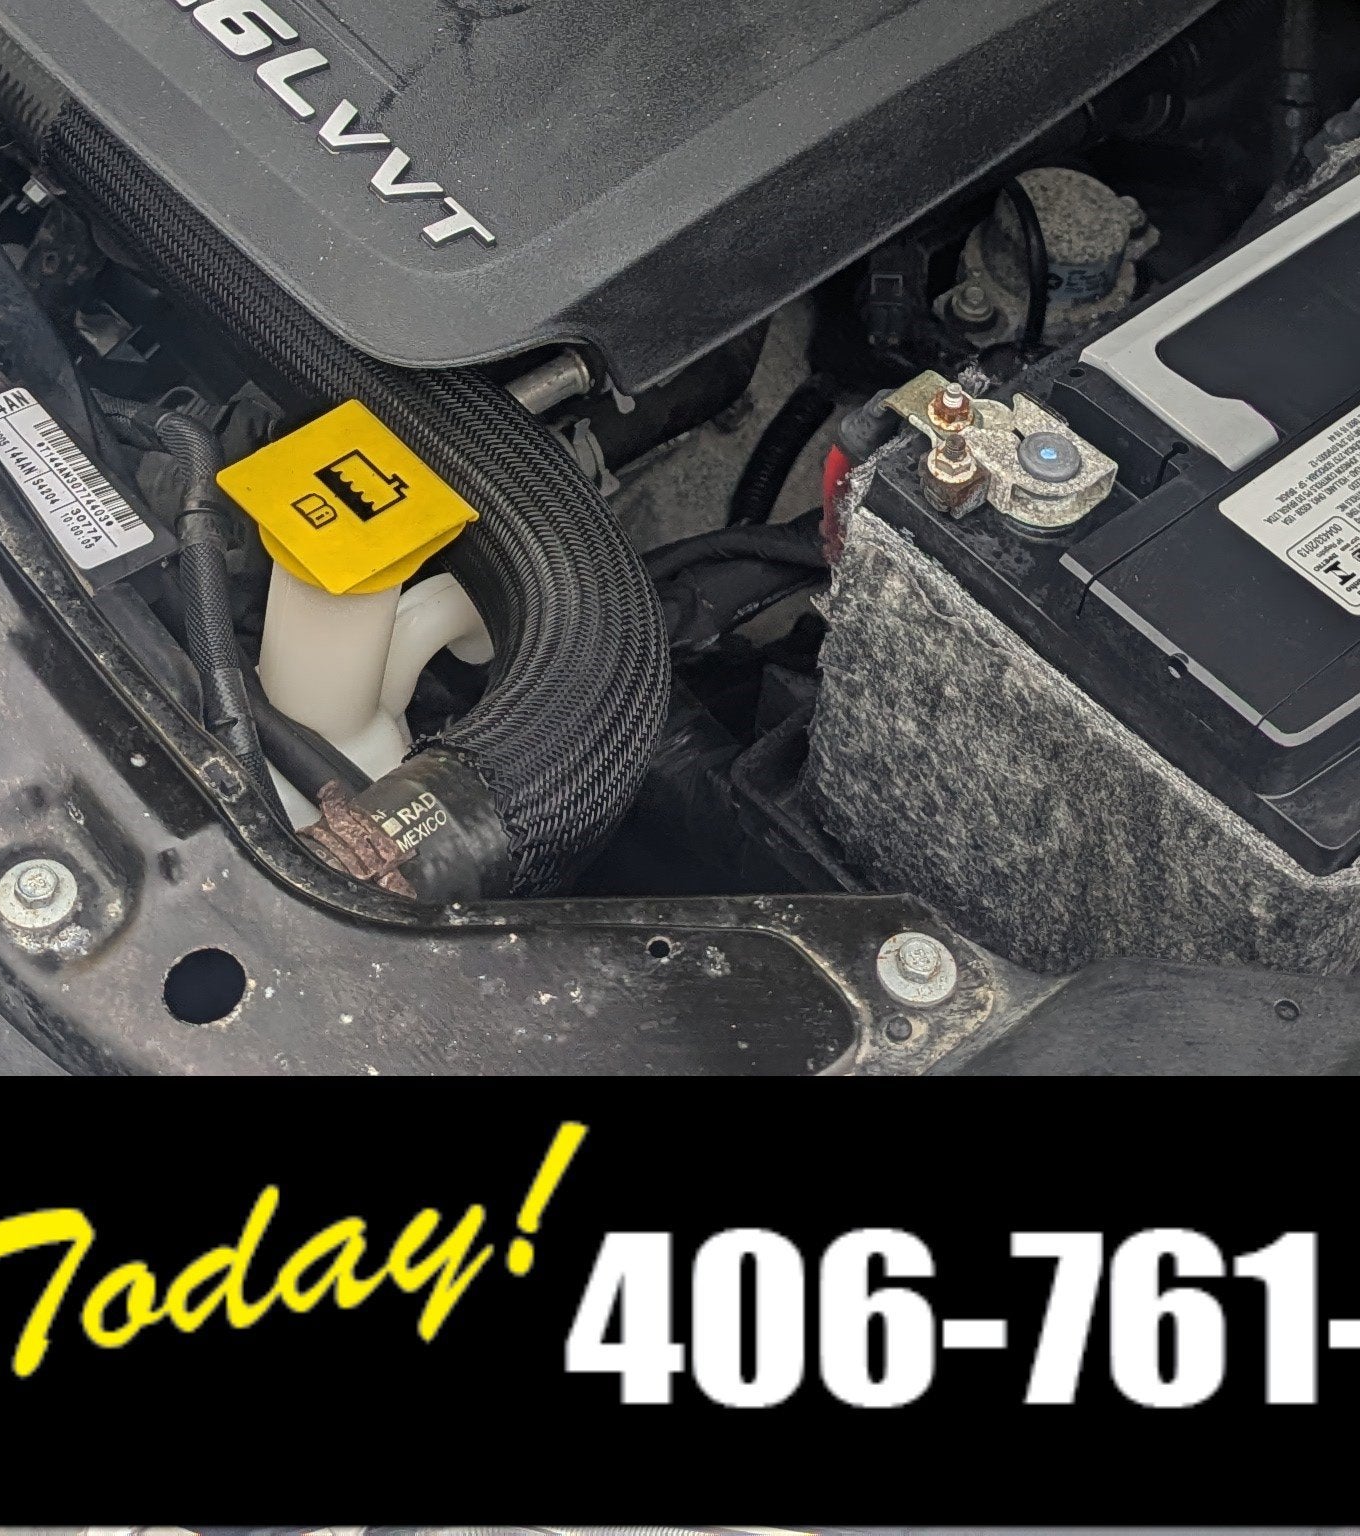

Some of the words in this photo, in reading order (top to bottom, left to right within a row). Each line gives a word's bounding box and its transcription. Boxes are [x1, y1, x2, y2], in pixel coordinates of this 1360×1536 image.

[317, 97, 497, 251] VVT
[3, 444, 38, 476] 144AN
[30, 477, 61, 506] S4204
[69, 507, 104, 543] 3077A
[1294, 522, 1343, 558] 004433/2013
[396, 792, 436, 825] RAD
[396, 810, 447, 853] MEXICO
